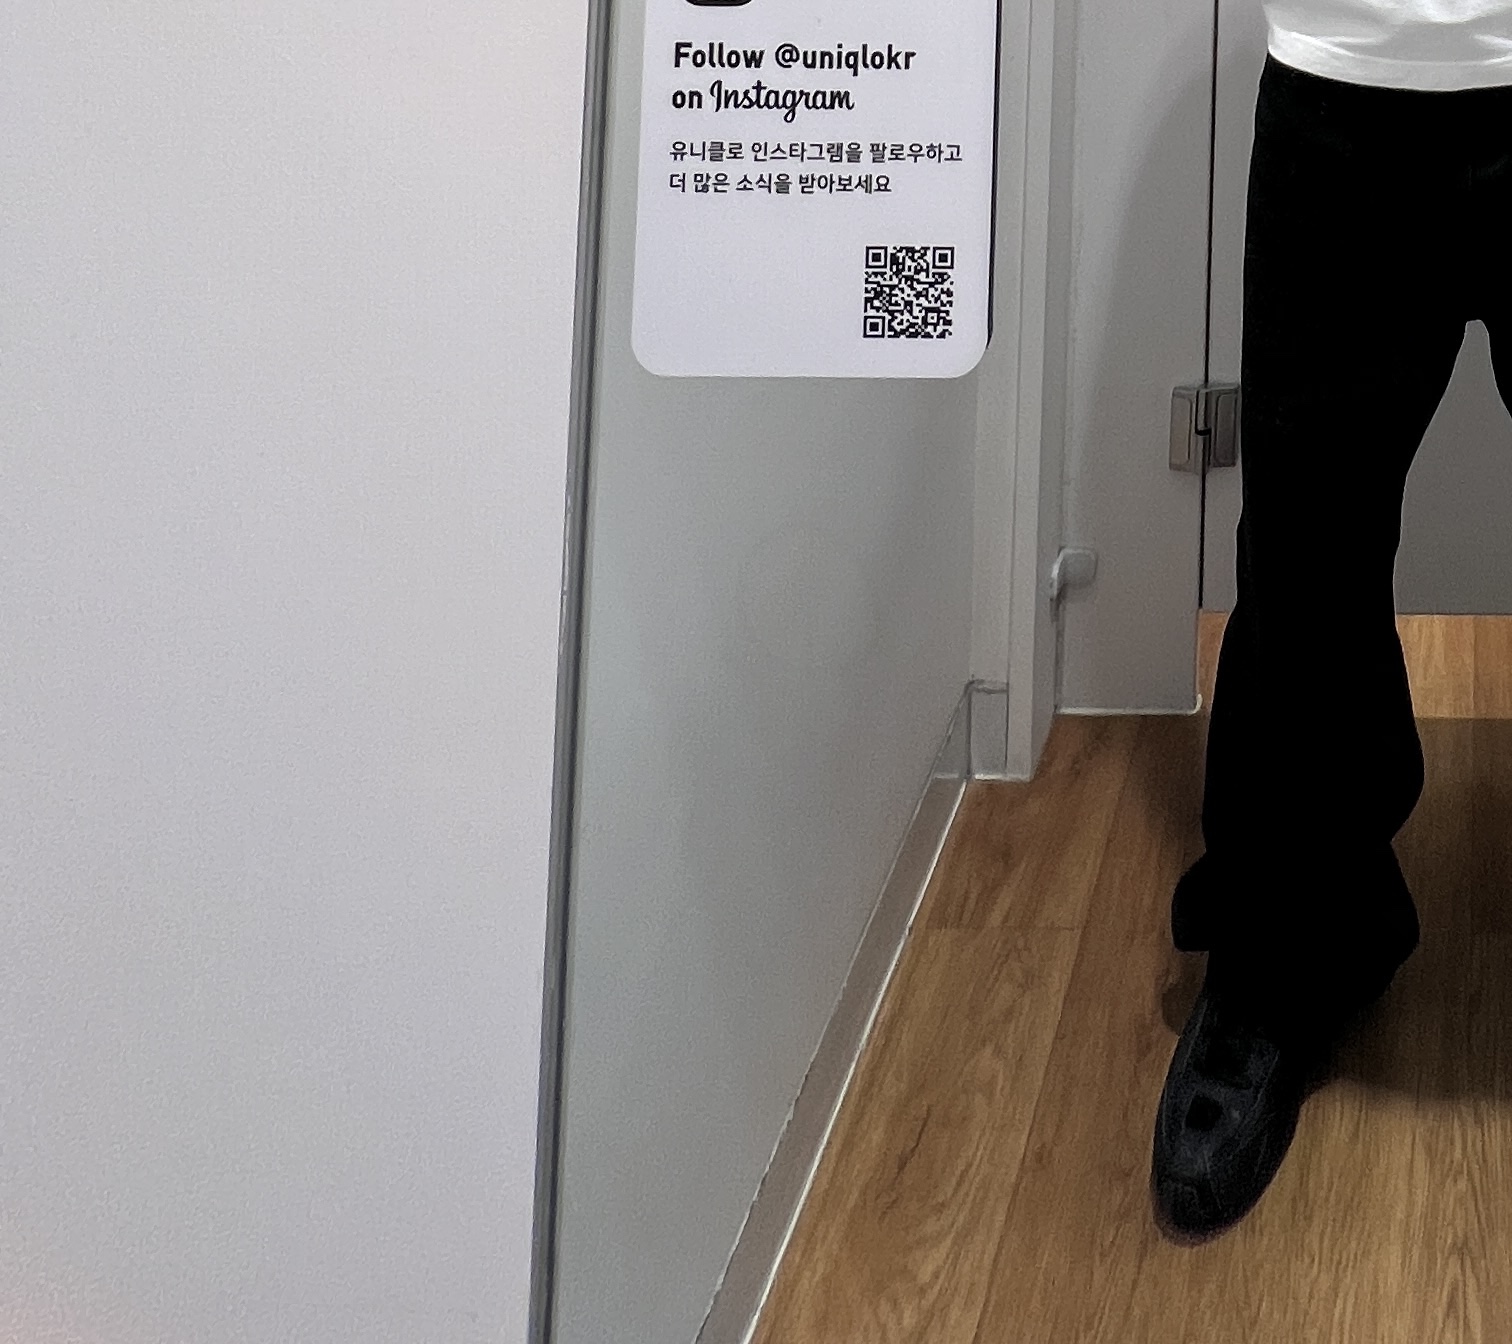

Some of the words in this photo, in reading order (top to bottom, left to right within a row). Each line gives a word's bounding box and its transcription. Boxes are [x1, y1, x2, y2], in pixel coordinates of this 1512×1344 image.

[673, 41, 766, 69] Follow
[774, 42, 917, 78] @uniqlokr
[671, 89, 703, 110] on
[709, 79, 856, 124] Instagram
[669, 140, 745, 163] 유니클로
[751, 141, 864, 164] 인스타그램을
[869, 142, 963, 164] 팔로우하고
[669, 172, 687, 193] 더
[693, 172, 731, 194] 많은
[735, 172, 793, 195] 소식을
[798, 172, 892, 195] 받아보세요
